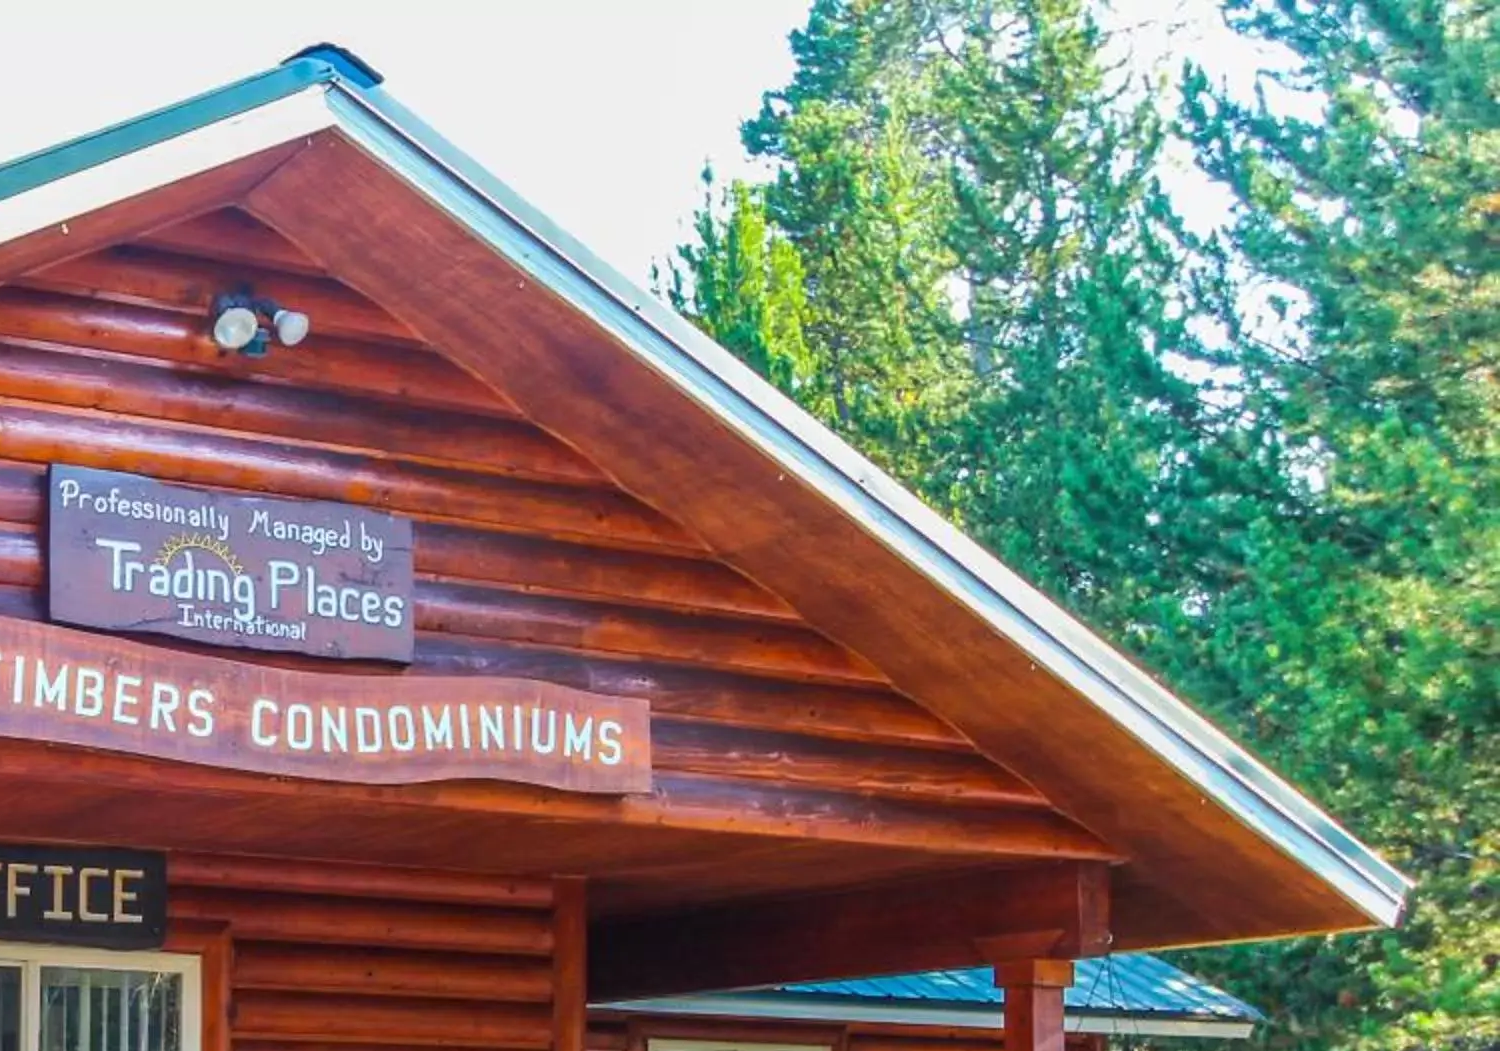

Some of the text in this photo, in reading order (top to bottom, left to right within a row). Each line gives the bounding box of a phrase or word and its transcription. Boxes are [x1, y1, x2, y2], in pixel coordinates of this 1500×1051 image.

[59, 479, 384, 563] Professionally Managed by
[96, 537, 403, 628] Trading Places
[178, 604, 306, 641] International
[251, 699, 623, 765] CONDOMINIUMS
